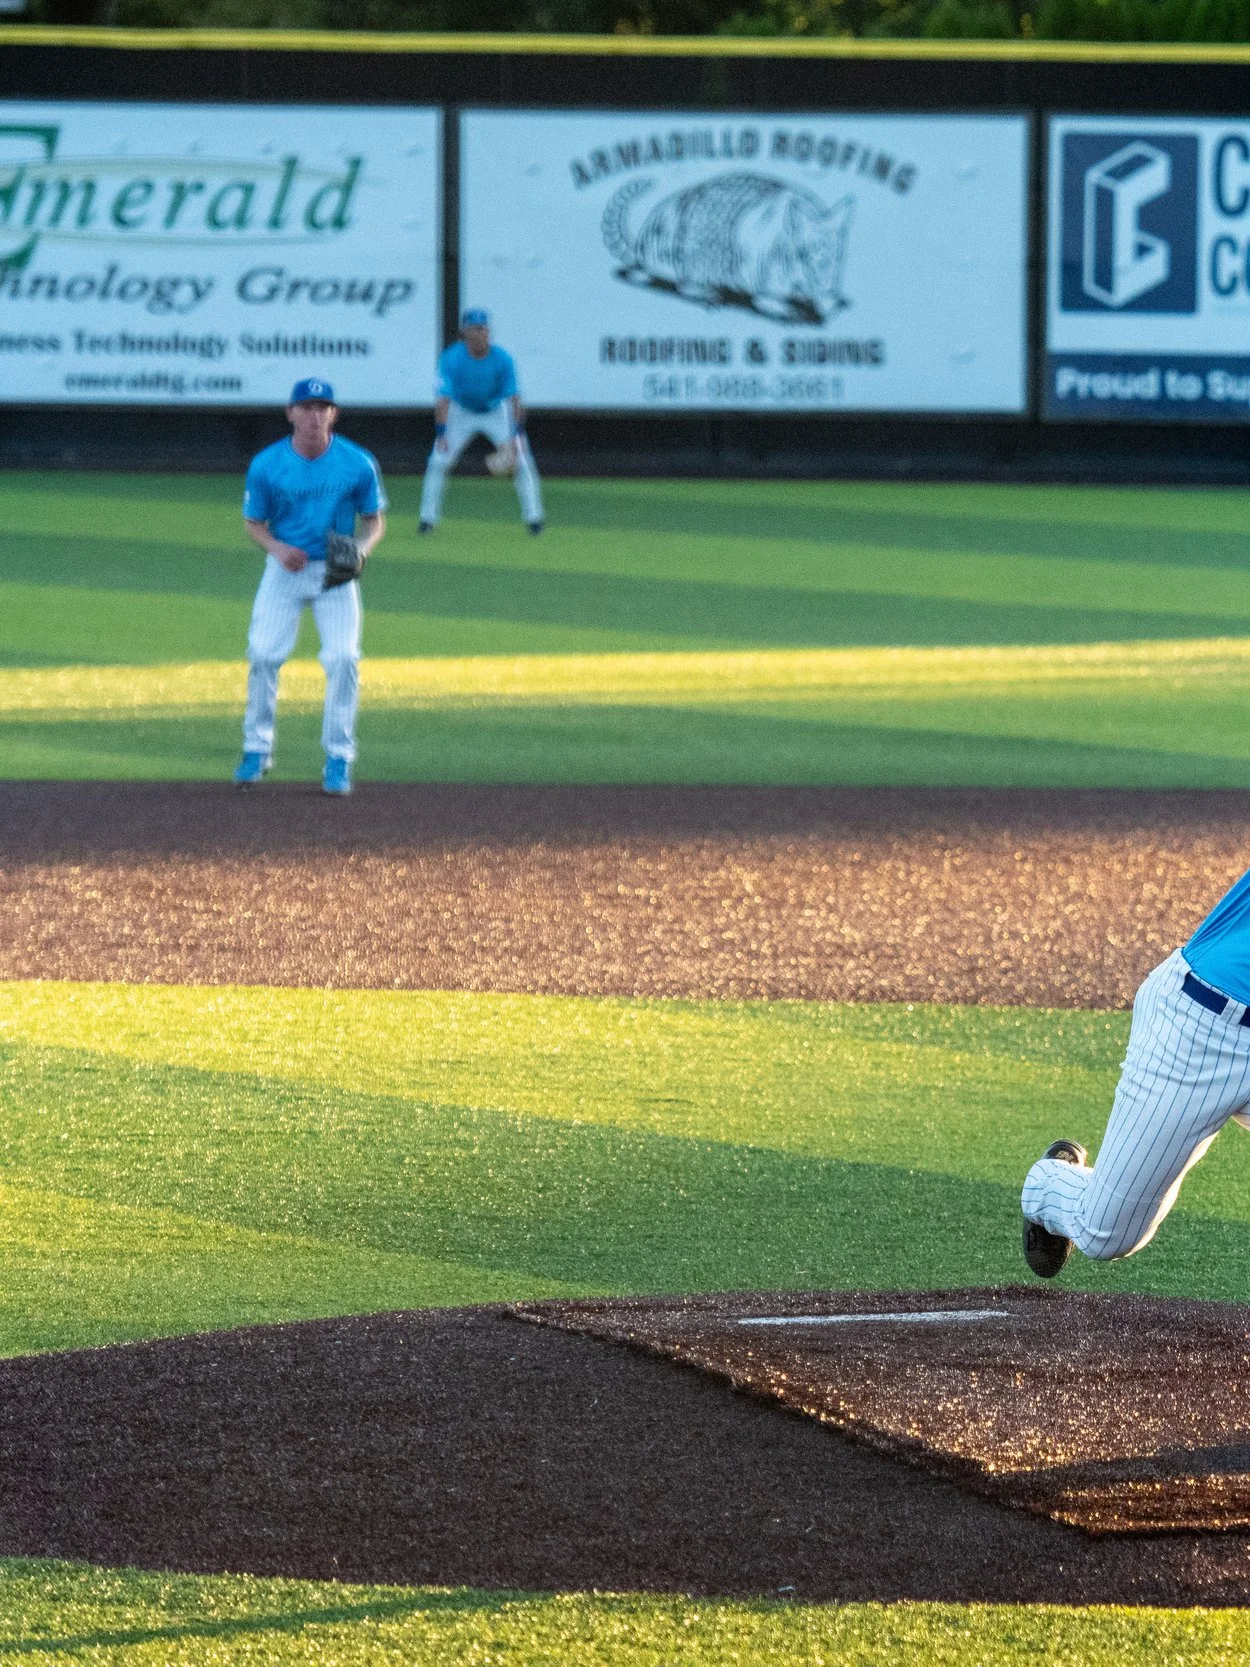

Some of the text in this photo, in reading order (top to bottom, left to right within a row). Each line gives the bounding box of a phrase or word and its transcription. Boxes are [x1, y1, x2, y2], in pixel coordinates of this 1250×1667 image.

[568, 124, 918, 196] ARMADILLO ROOFING
[236, 265, 416, 317] Group
[70, 327, 230, 359] Technology
[238, 329, 371, 358] Solutions
[600, 335, 886, 369] ROOFING & SIDING
[1055, 365, 1161, 401] Proud
[1163, 367, 1203, 402] to
